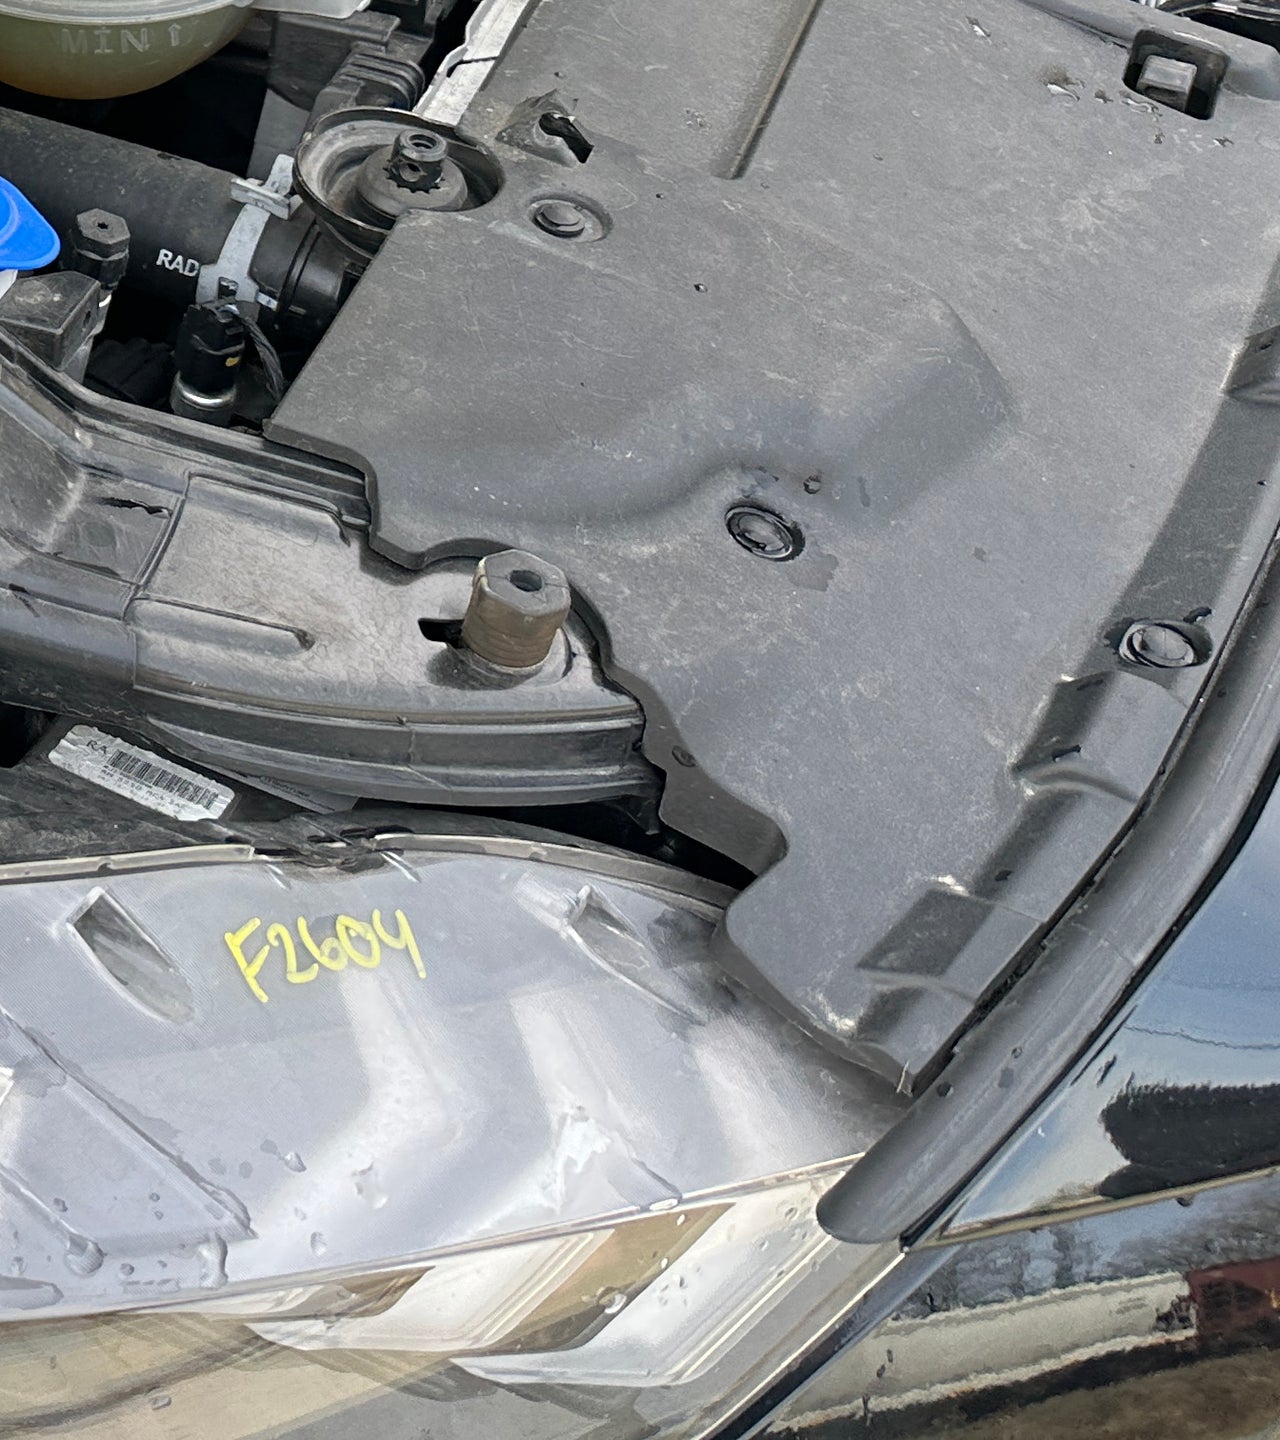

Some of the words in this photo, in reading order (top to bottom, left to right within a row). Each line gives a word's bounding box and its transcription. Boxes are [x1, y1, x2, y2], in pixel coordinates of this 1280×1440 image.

[60, 26, 153, 55] MIN
[155, 248, 200, 277] RAD
[224, 908, 427, 1004] F2604
